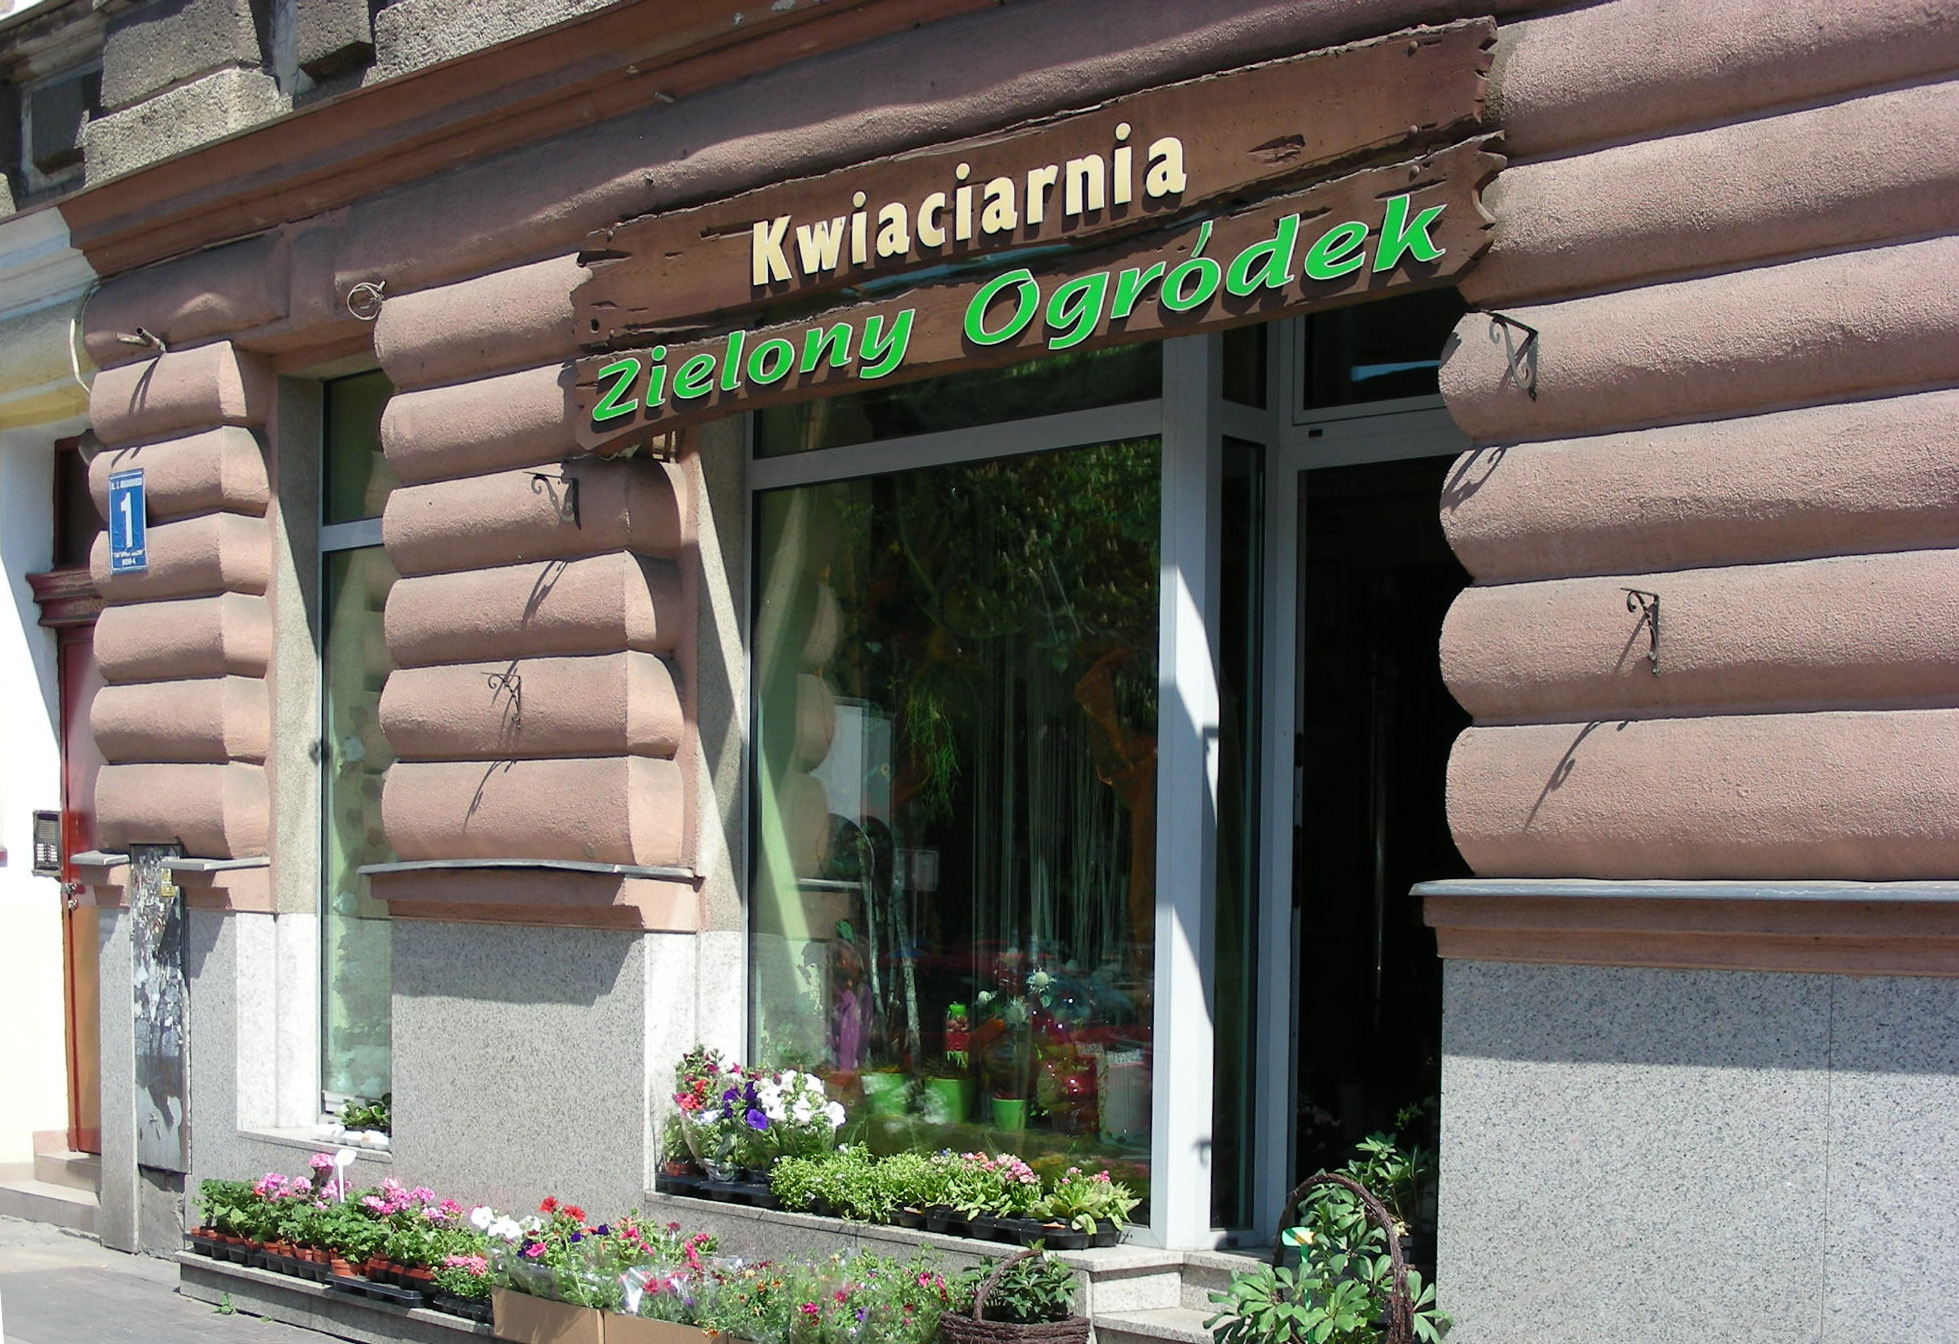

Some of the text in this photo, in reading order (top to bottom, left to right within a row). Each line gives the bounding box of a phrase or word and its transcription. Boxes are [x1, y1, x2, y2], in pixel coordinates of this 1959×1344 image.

[752, 122, 1188, 287] Kwiaciarnia
[590, 193, 1448, 423] Zielony Ogródek
[120, 491, 133, 549] 1
